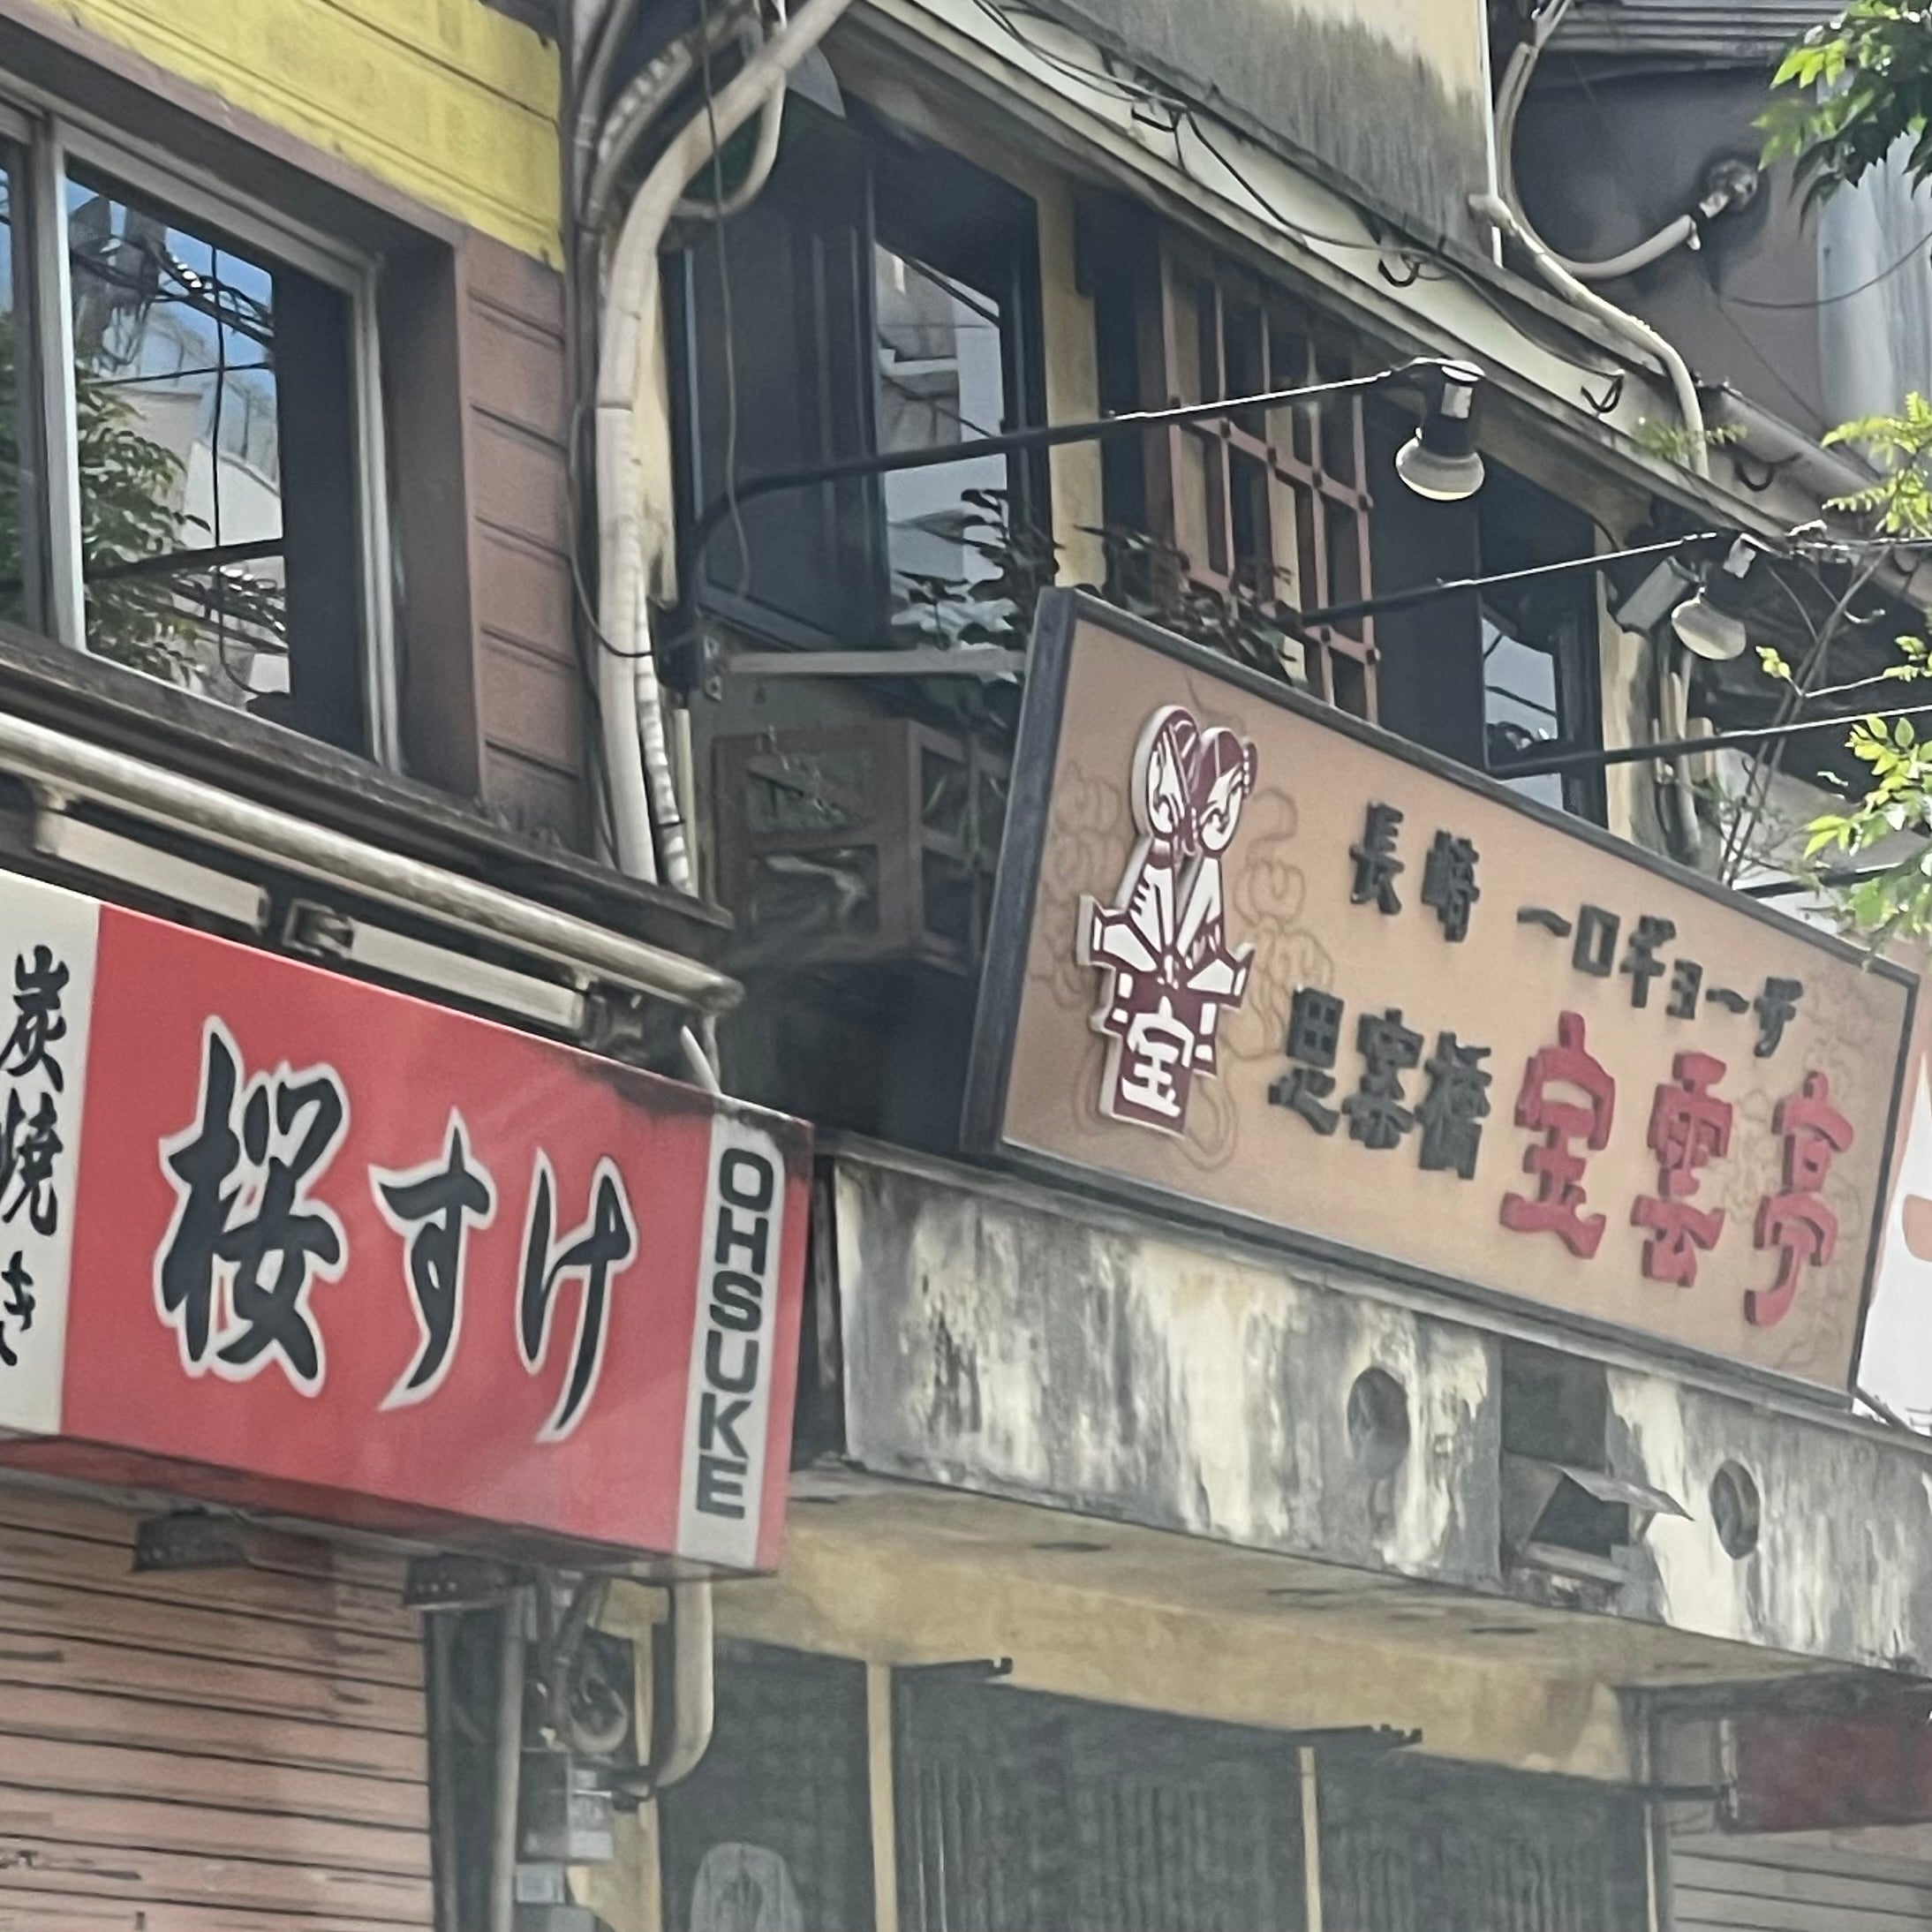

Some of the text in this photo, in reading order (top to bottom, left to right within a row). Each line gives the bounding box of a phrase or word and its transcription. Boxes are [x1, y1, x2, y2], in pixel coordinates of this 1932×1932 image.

[153, 1014, 638, 1443] 桜すけ
[1121, 995, 1195, 1118] 宝
[1500, 1010, 1853, 1327] 宝雲亭
[695, 1147, 774, 1521] OHSUKE
